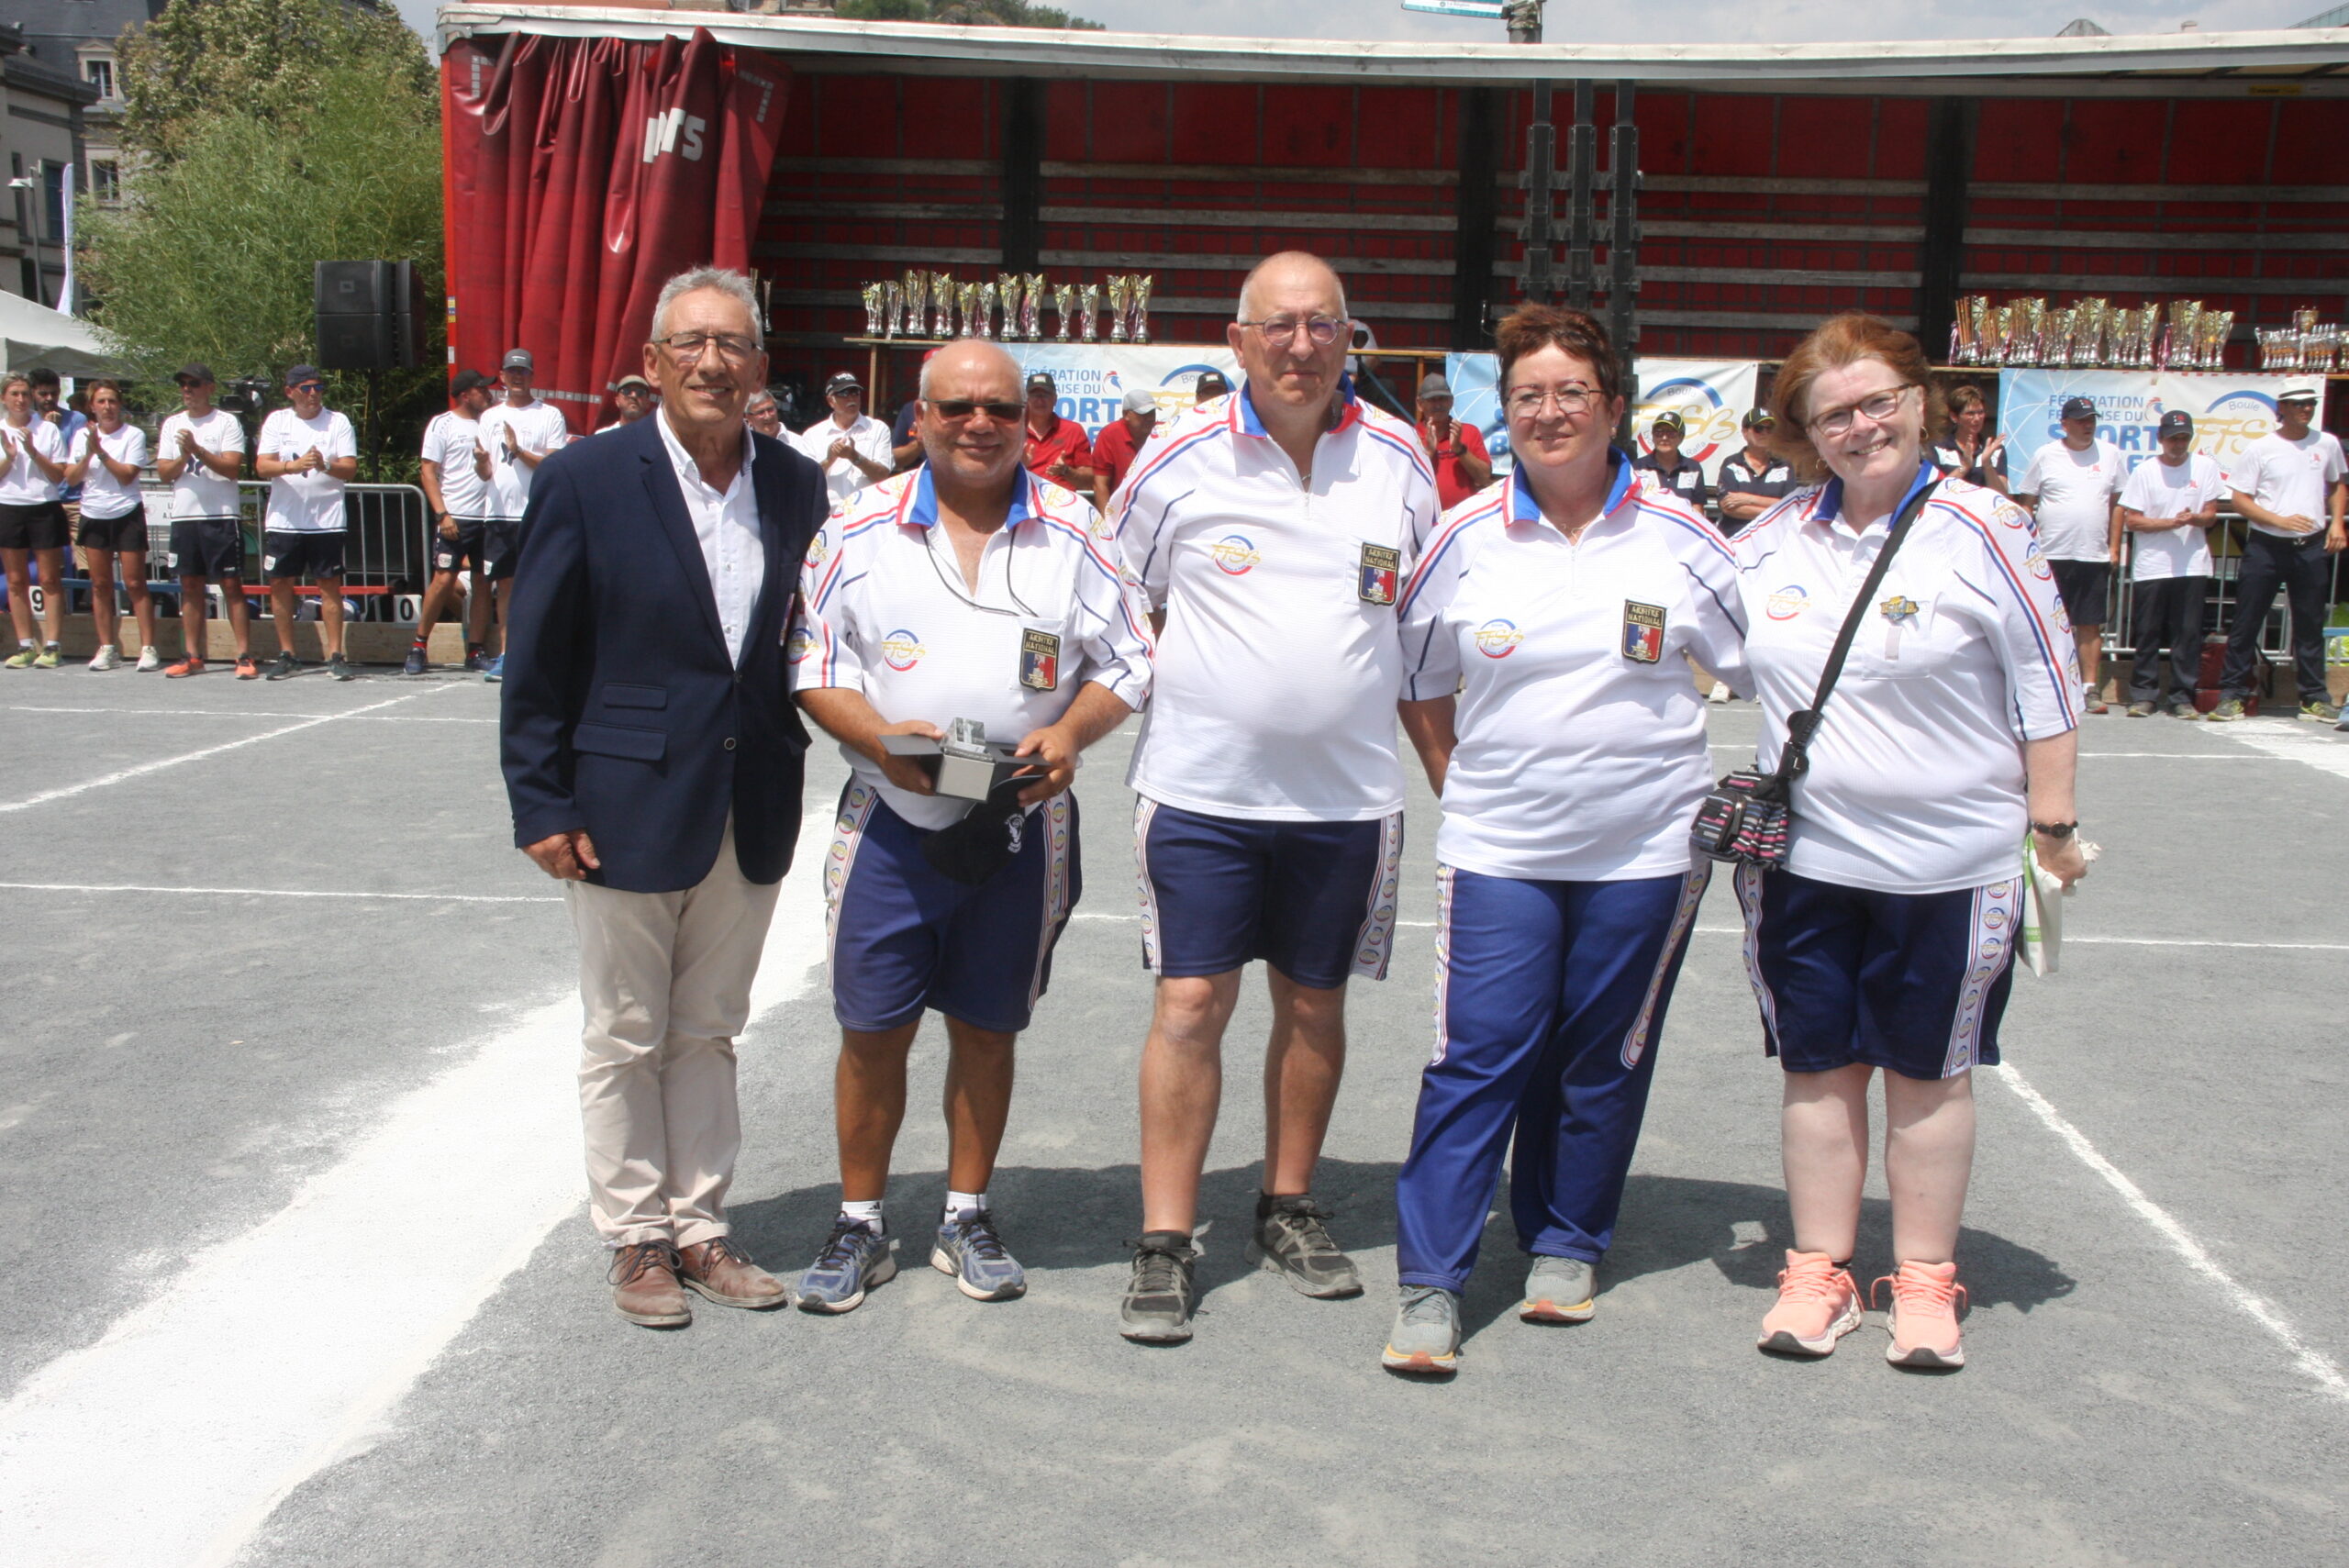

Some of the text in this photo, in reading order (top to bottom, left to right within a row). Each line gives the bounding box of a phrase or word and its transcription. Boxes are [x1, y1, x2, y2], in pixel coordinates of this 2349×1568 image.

[1020, 366, 1101, 382] ÉDÉRATION
[1084, 384, 1101, 395] DU
[2048, 392, 2144, 409] FÉRATION
[2228, 401, 2260, 412] Boule
[1053, 396, 1122, 423] ORT
[2124, 410, 2143, 422] DU
[2047, 423, 2159, 451] SORT
[31, 589, 44, 612] 9
[1631, 606, 1660, 617] ARBITRE
[1628, 613, 1661, 627] NATIONAL
[1029, 633, 1054, 646] ARBITRE
[1025, 641, 1055, 655] NATIONAL
